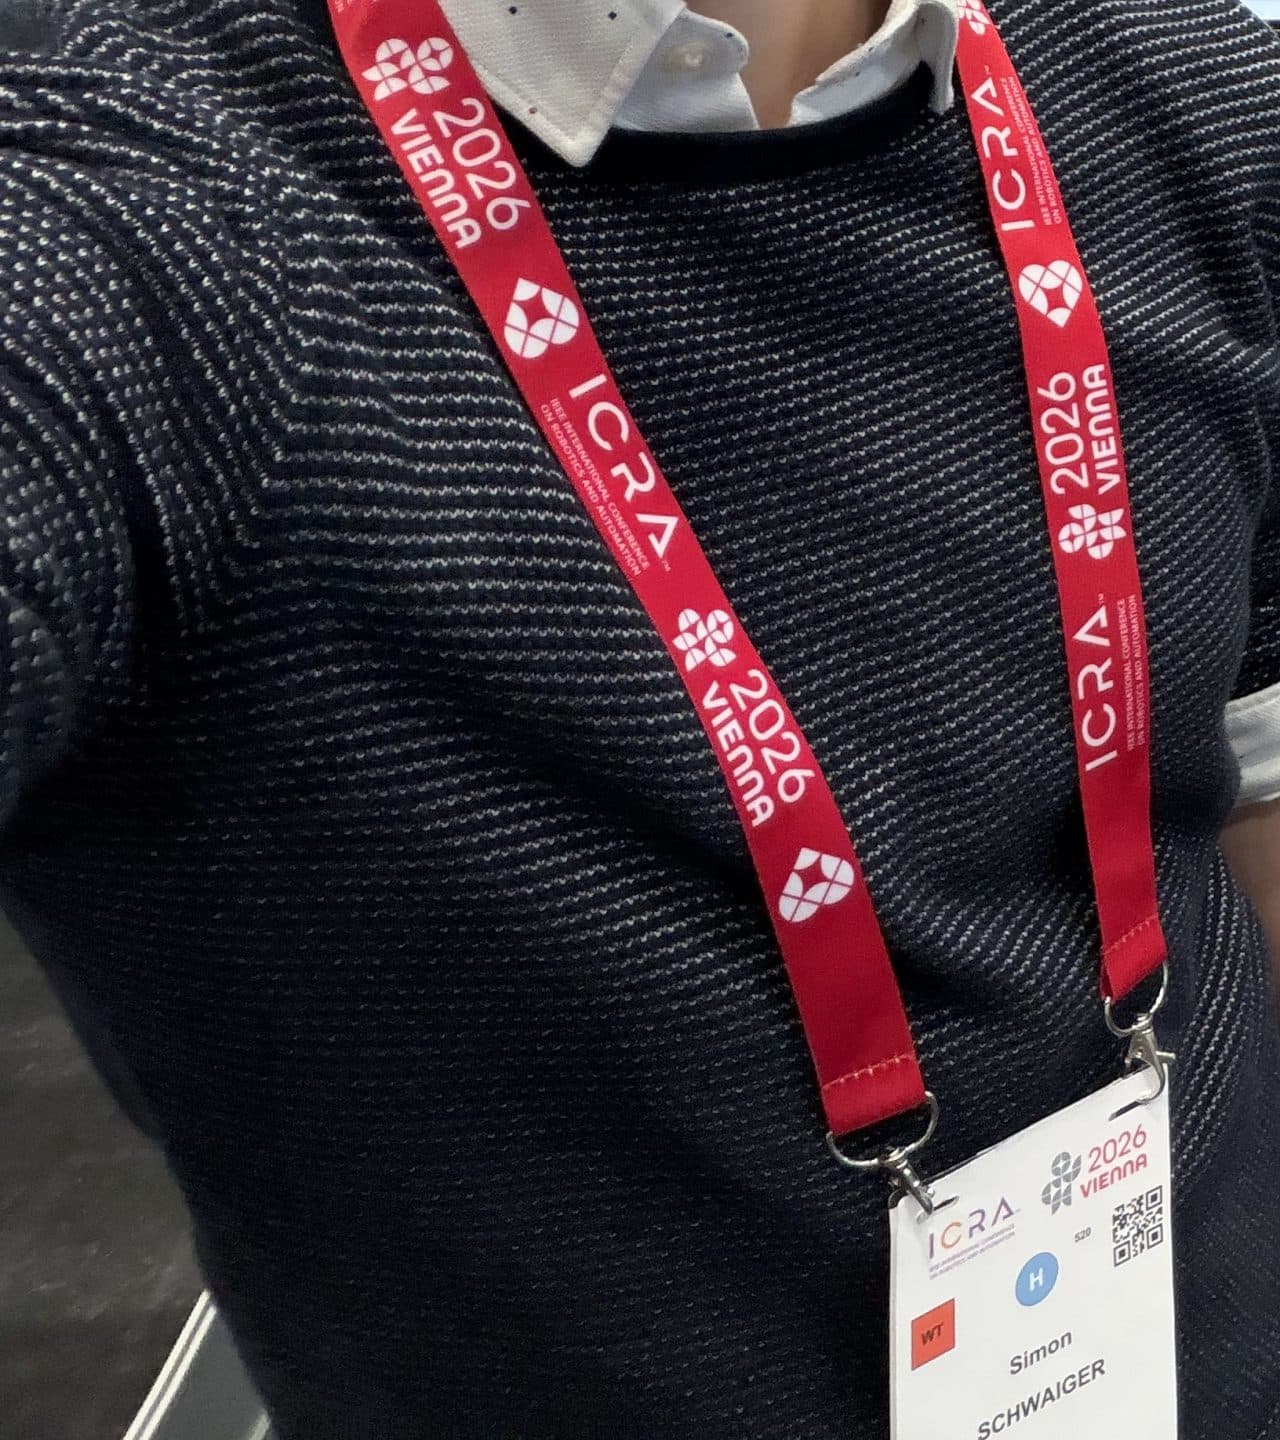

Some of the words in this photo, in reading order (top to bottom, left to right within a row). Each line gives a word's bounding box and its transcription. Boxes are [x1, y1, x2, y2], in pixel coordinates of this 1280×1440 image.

[391, 108, 483, 250] VIENNA
[433, 97, 532, 231] 2026
[971, 76, 1035, 232] ICRA
[540, 404, 555, 423] ON
[551, 421, 586, 480] ROBOTICS
[581, 477, 600, 505] AND
[596, 504, 643, 577] AUTOMATION
[550, 398, 566, 424] IEEE
[562, 420, 611, 504] INTERNATIONAL
[607, 502, 650, 570] CONFERENCE
[568, 373, 680, 559] ICRA
[1036, 371, 1089, 496] 2026
[1082, 363, 1121, 495] VIENNA
[702, 680, 775, 828] VIENNA
[729, 669, 816, 803] 2026
[1072, 605, 1119, 773] ICRA
[1079, 1153, 1149, 1199] VIENNA
[1088, 1123, 1148, 1173] 2026
[928, 1196, 1016, 1260] ICRA
[1028, 1270, 1045, 1291] H
[921, 1321, 945, 1346] WT
[977, 1358, 1106, 1440] SCHWAIGER
[1009, 1331, 1072, 1376] Simon
